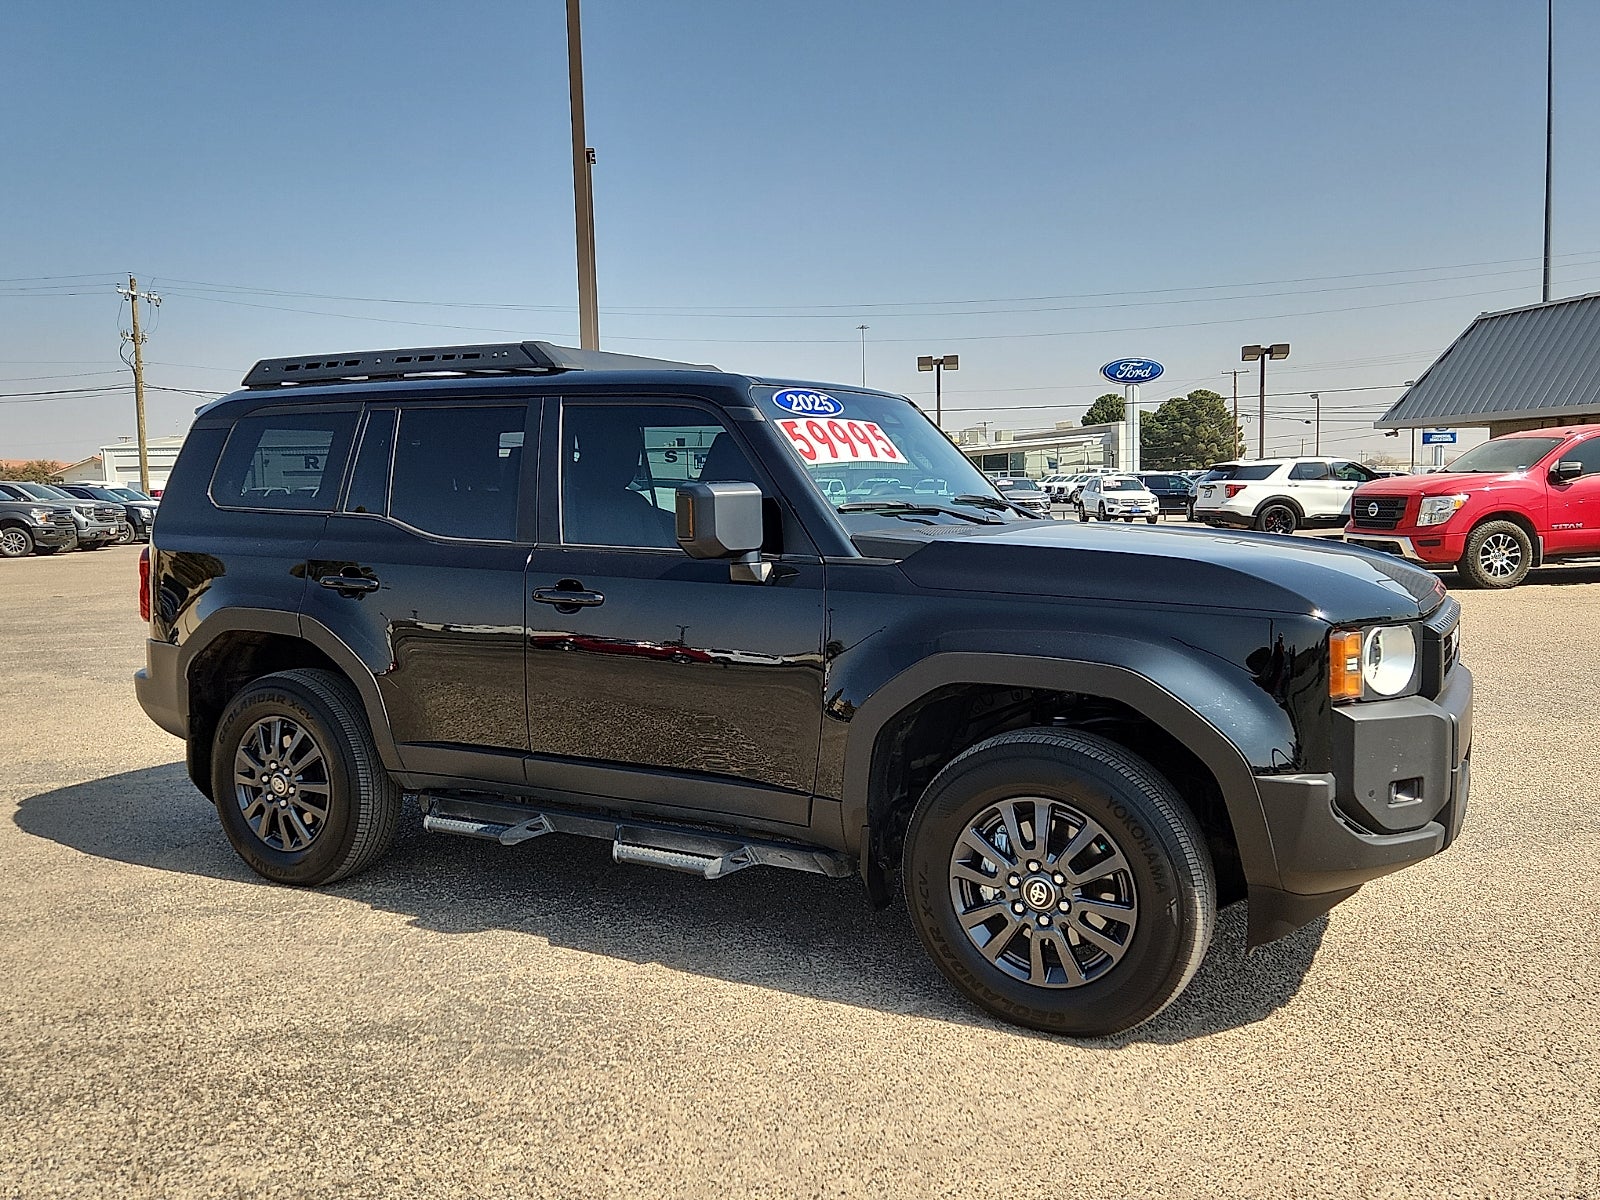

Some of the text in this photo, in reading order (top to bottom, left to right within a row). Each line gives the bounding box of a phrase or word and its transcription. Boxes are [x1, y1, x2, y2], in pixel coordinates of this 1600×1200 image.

[1116, 362, 1153, 379] Ford
[786, 393, 835, 413] 2025
[781, 420, 897, 461] 59995
[304, 455, 319, 469] R
[665, 450, 677, 463] S
[1106, 795, 1164, 895] YOKOHAMA
[928, 924, 1066, 1026] GEOLANDAR
